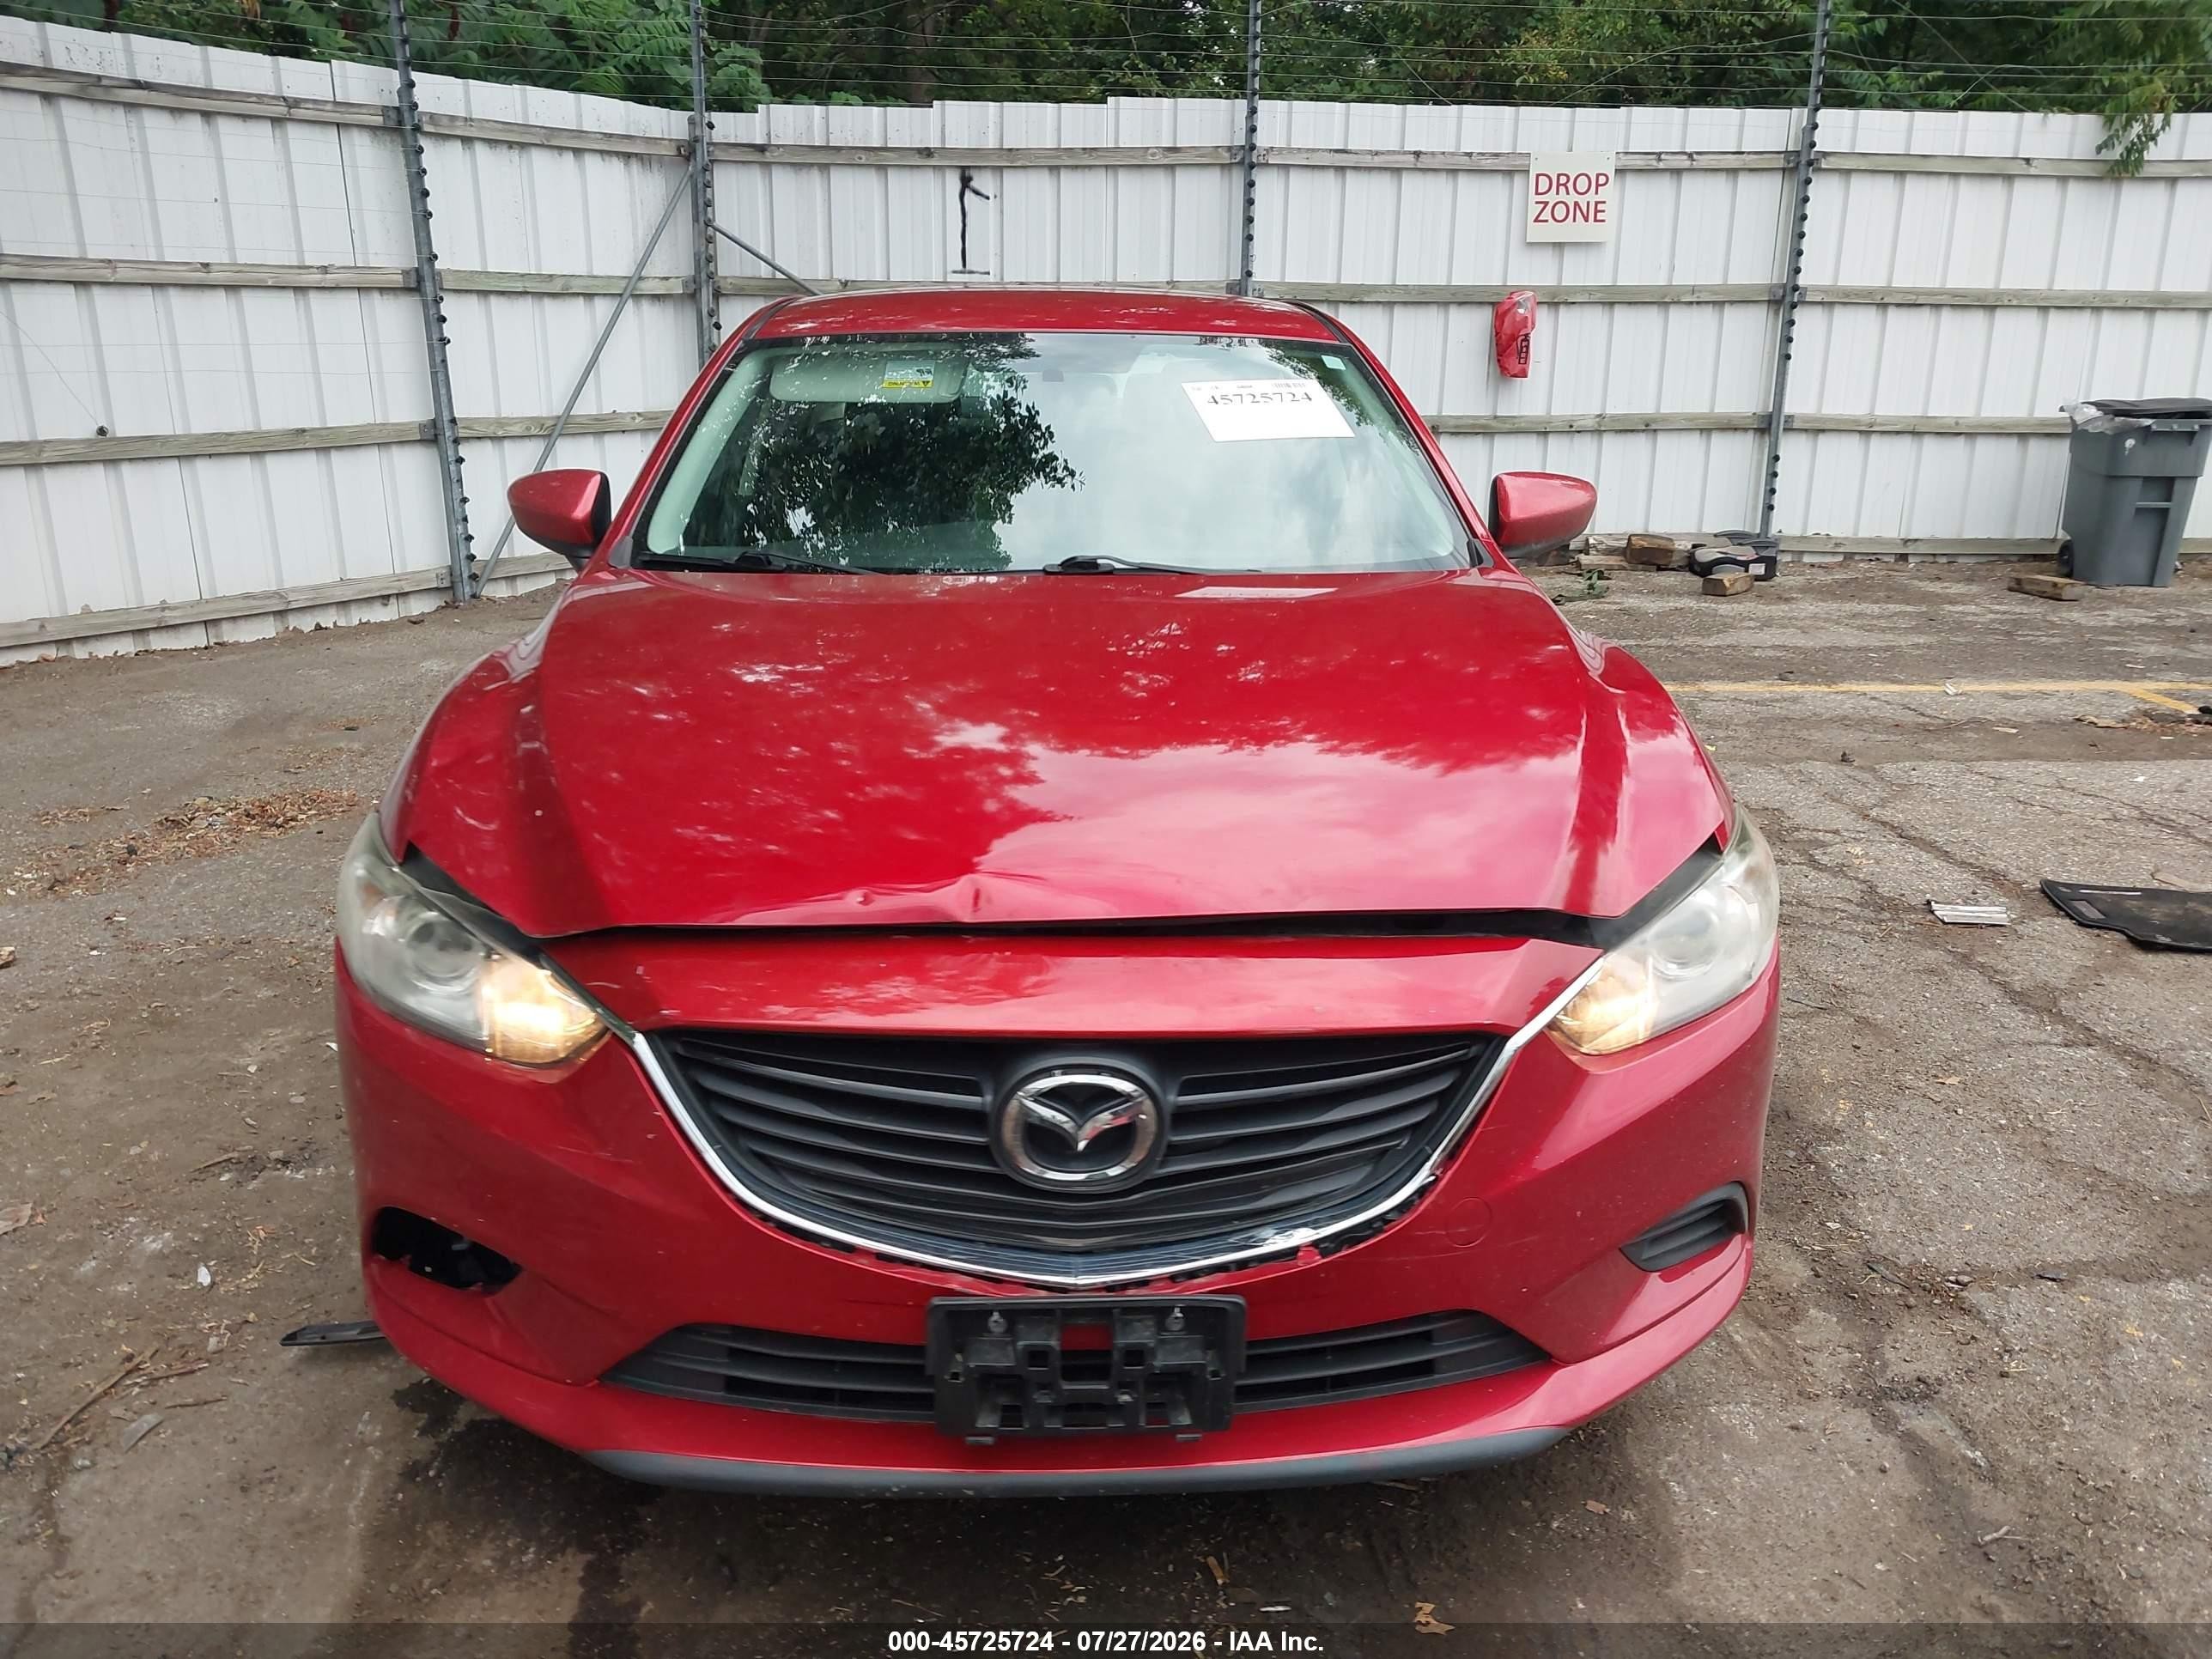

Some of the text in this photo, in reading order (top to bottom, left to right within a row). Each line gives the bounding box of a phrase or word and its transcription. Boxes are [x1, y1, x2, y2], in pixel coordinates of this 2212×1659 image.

[1534, 173, 1610, 196] DROP
[1533, 200, 1607, 223] ZONE
[1206, 392, 1313, 405] 45725724
